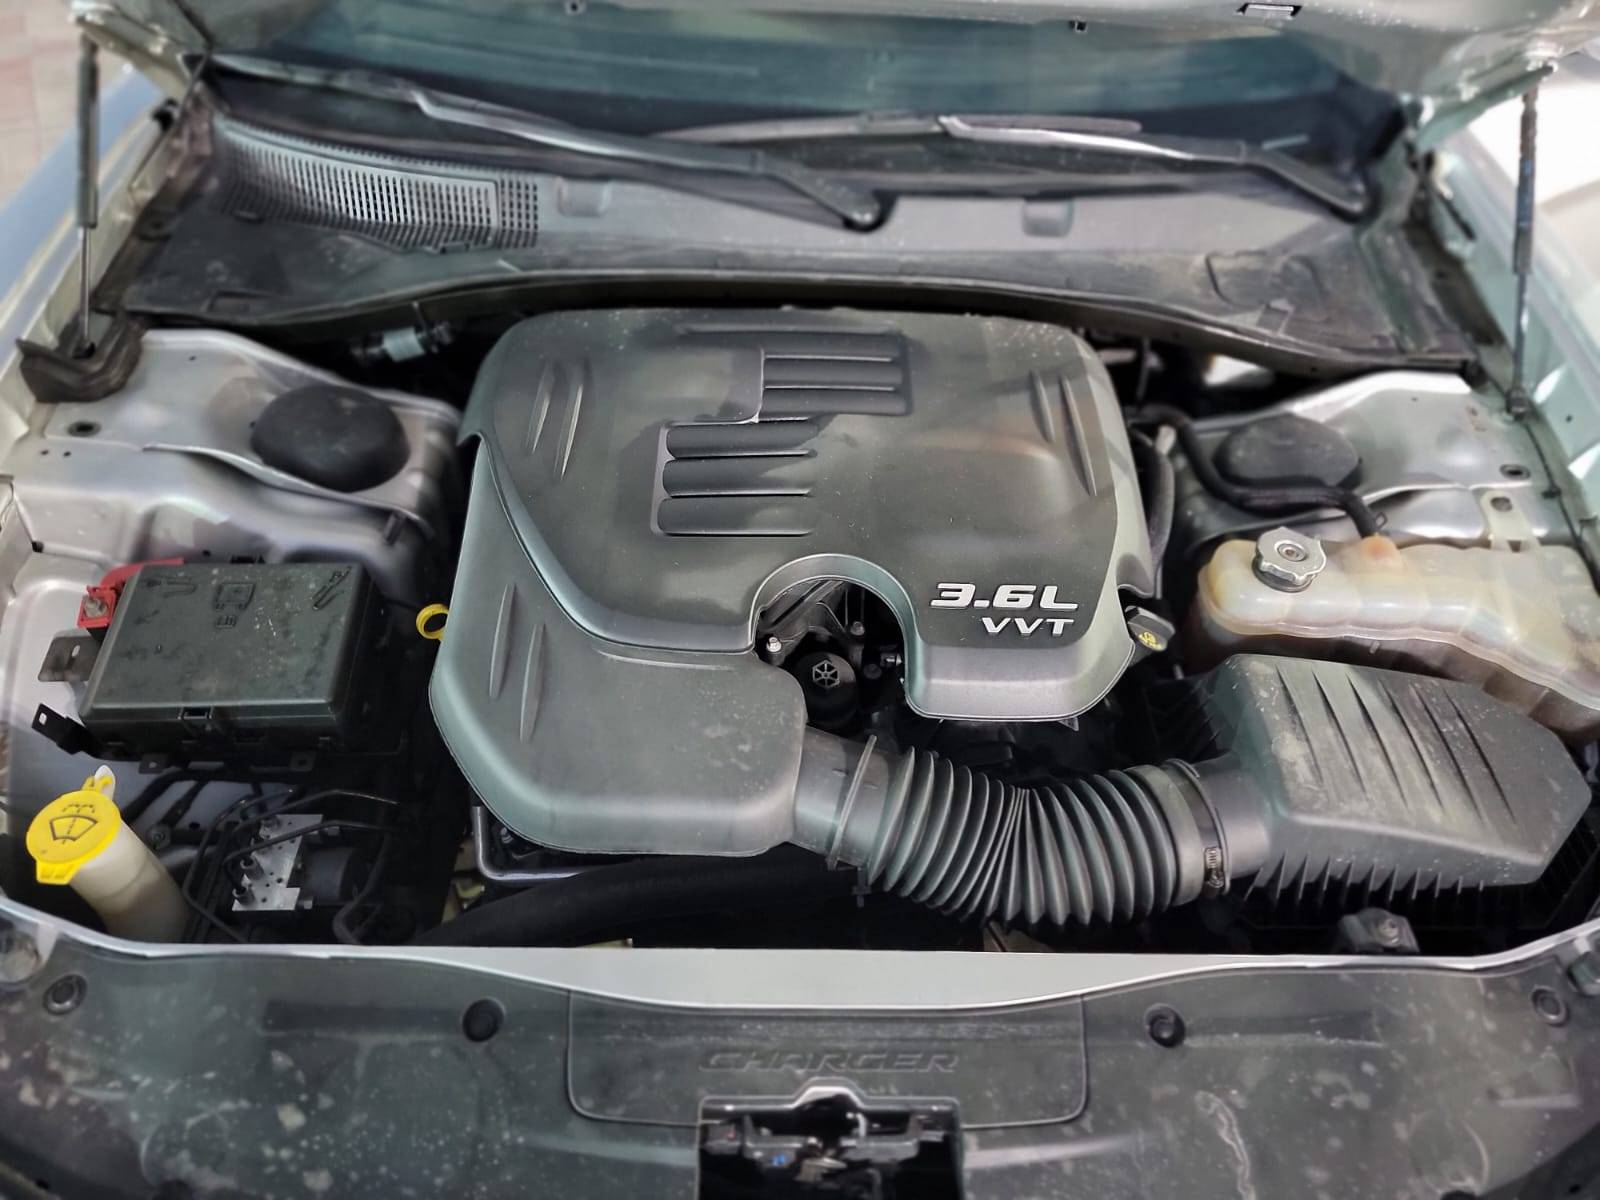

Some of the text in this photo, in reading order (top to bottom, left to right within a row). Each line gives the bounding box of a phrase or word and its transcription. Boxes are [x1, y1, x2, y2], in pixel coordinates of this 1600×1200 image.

[930, 582, 1079, 610] 3.6L
[981, 616, 1075, 636] VVT
[699, 1052, 959, 1073] CHARGER
